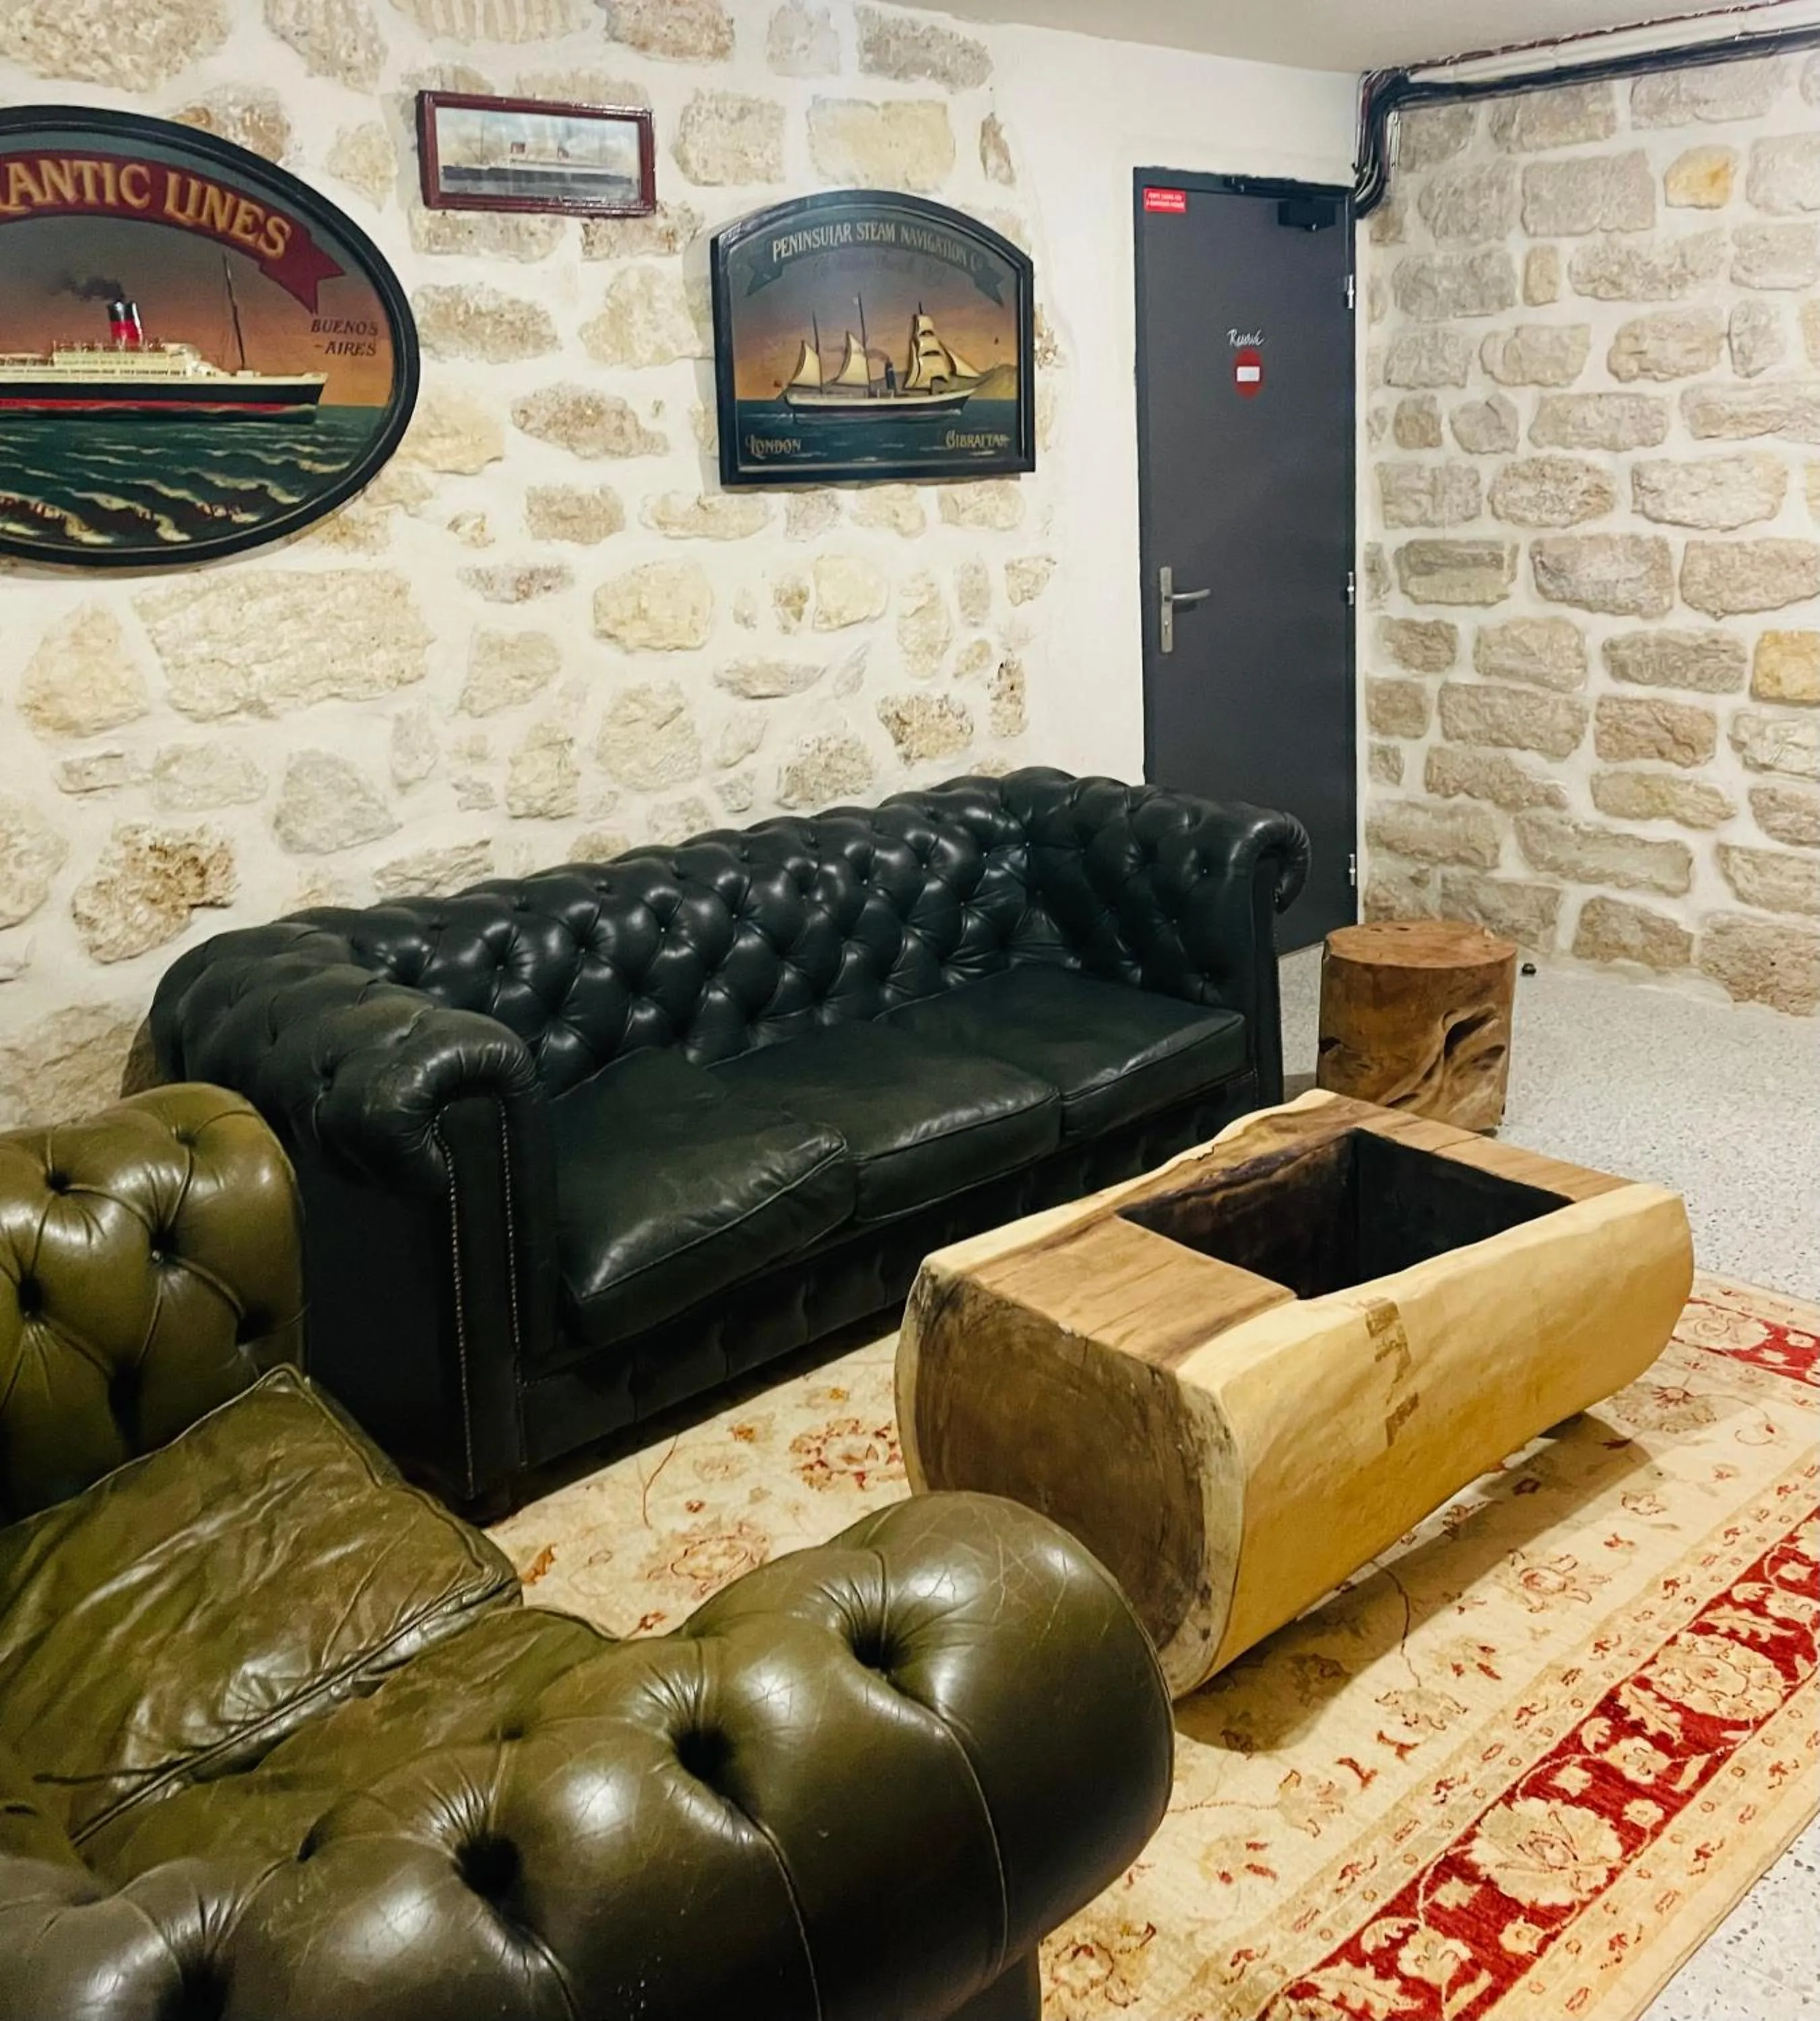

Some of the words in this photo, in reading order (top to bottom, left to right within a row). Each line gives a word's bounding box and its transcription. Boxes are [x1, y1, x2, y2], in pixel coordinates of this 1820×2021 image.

[164, 171, 292, 259] LINES
[772, 224, 853, 262] PENINSULAR
[856, 222, 896, 243] STEAM
[900, 226, 967, 267] NAVIGATION
[311, 319, 378, 336] BUENOS
[745, 435, 802, 460] LONDON
